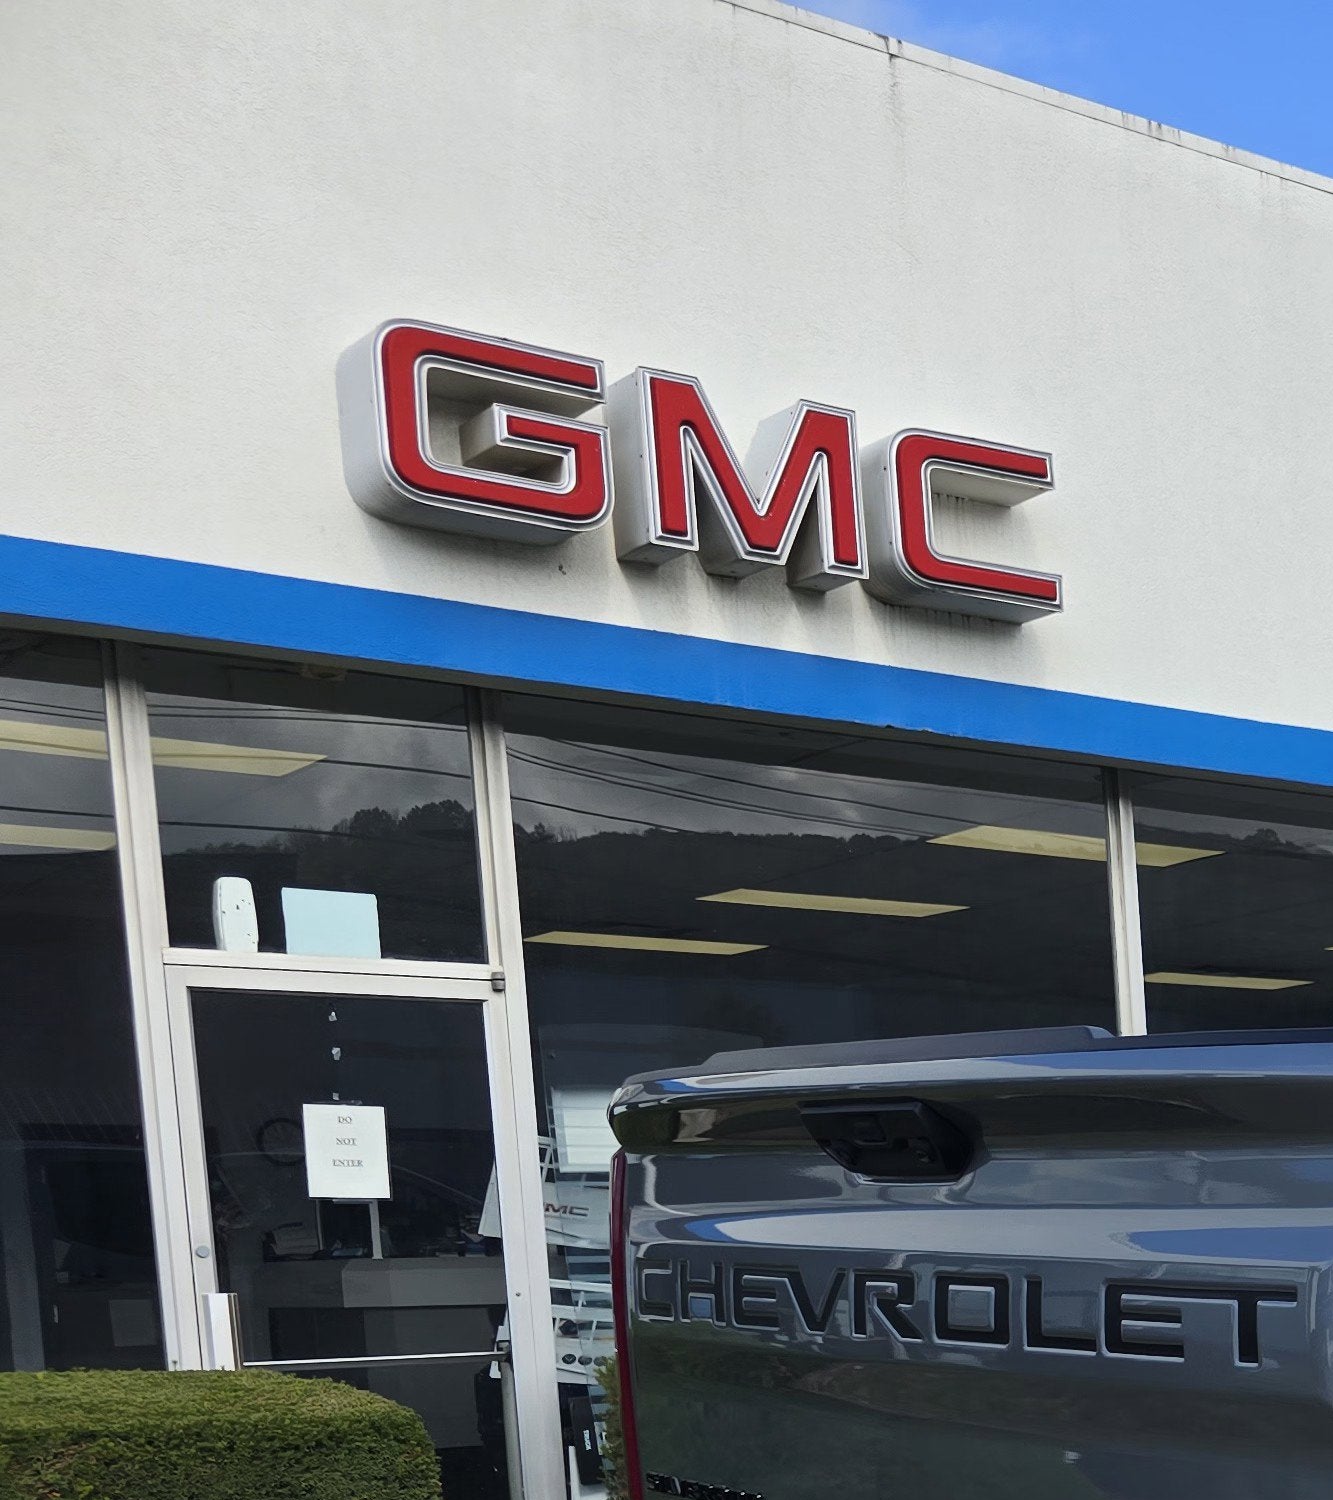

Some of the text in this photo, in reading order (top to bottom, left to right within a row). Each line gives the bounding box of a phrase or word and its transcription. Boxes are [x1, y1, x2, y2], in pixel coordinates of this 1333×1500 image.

[362, 317, 1064, 618] GMC
[337, 1115, 353, 1125] DO
[335, 1137, 359, 1147] NOT
[331, 1158, 364, 1168] ENTER
[543, 1202, 590, 1217] MC
[635, 1259, 1300, 1369] CHEVROLET
